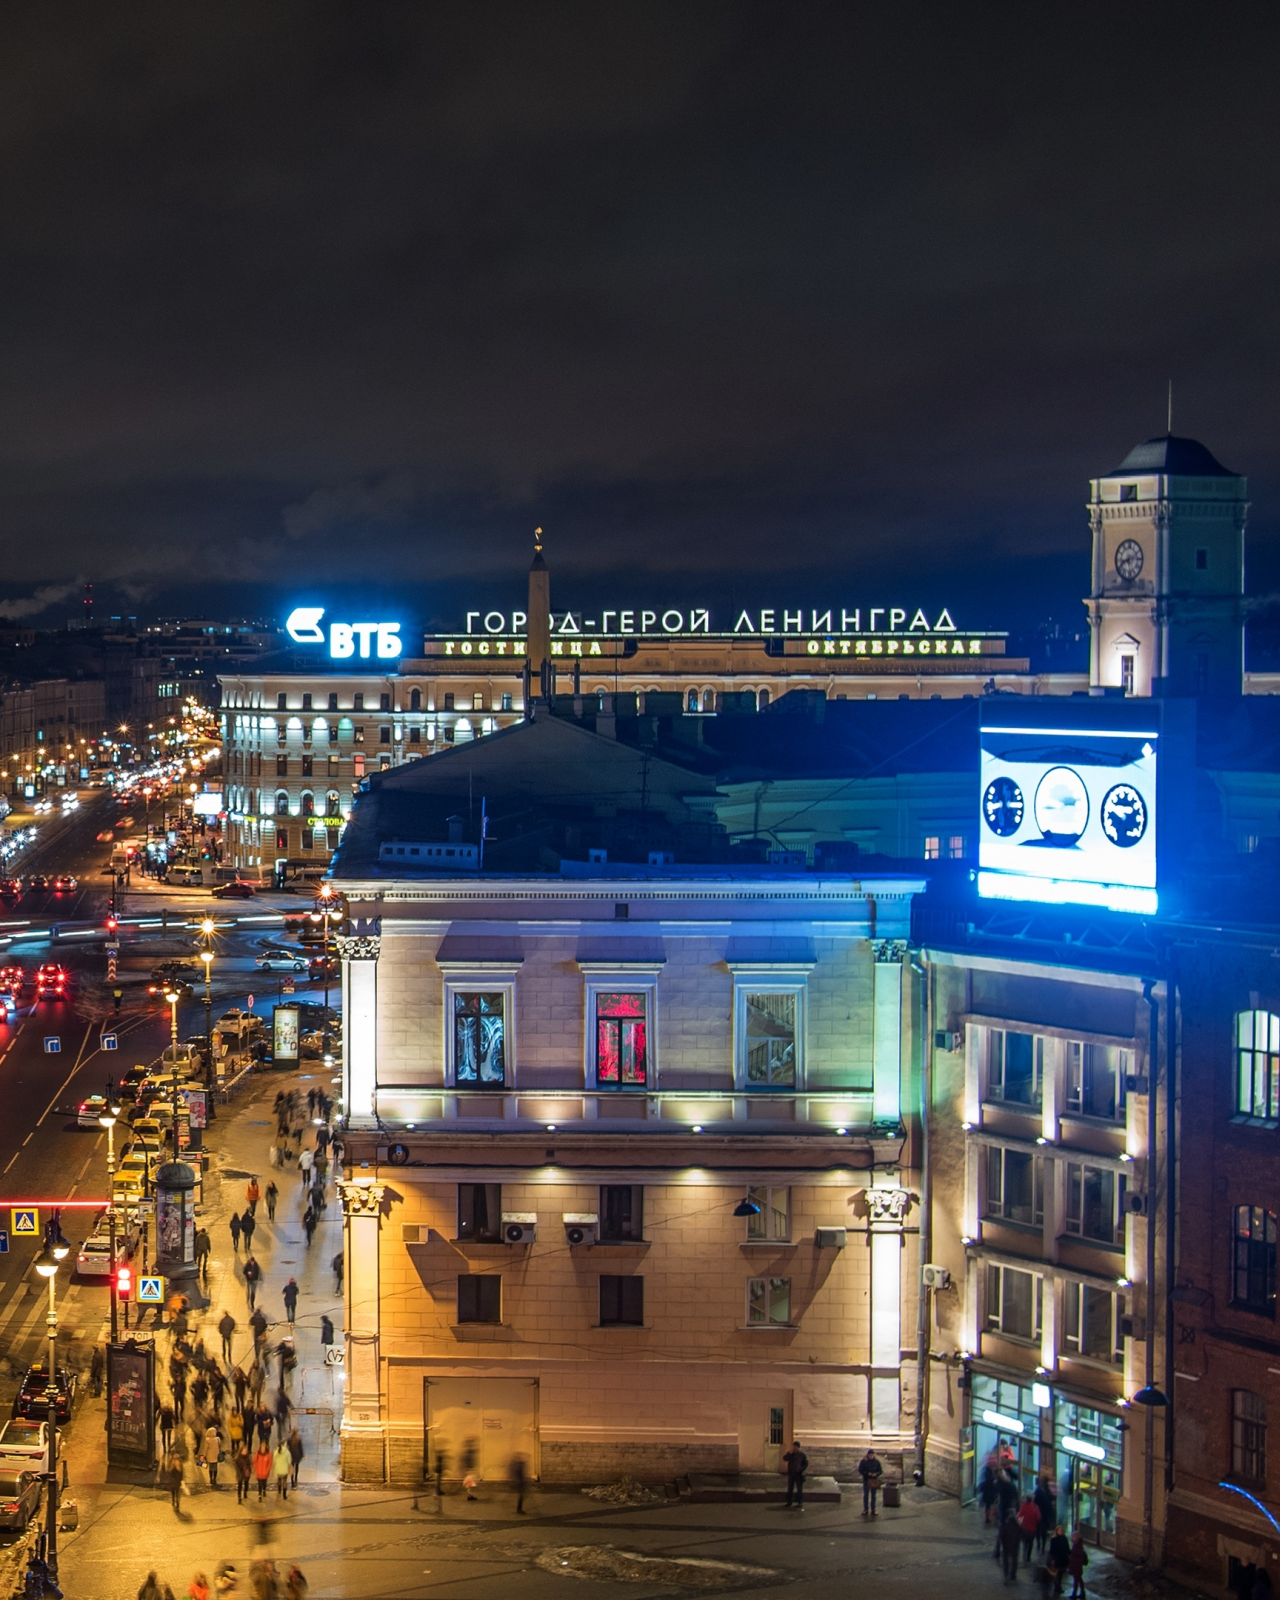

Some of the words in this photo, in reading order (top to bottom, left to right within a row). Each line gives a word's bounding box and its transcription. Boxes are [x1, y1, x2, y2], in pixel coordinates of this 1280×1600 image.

[466, 608, 710, 634] ГОРД-ГЕРОЙ
[733, 608, 958, 633] ЛЕНИНГРАД
[329, 622, 403, 659] ВТБ
[445, 641, 603, 657] ГОСТИИЦА
[807, 640, 982, 655] ОКТЯБРЬСКАЯ
[125, 1332, 149, 1340] СТОП
